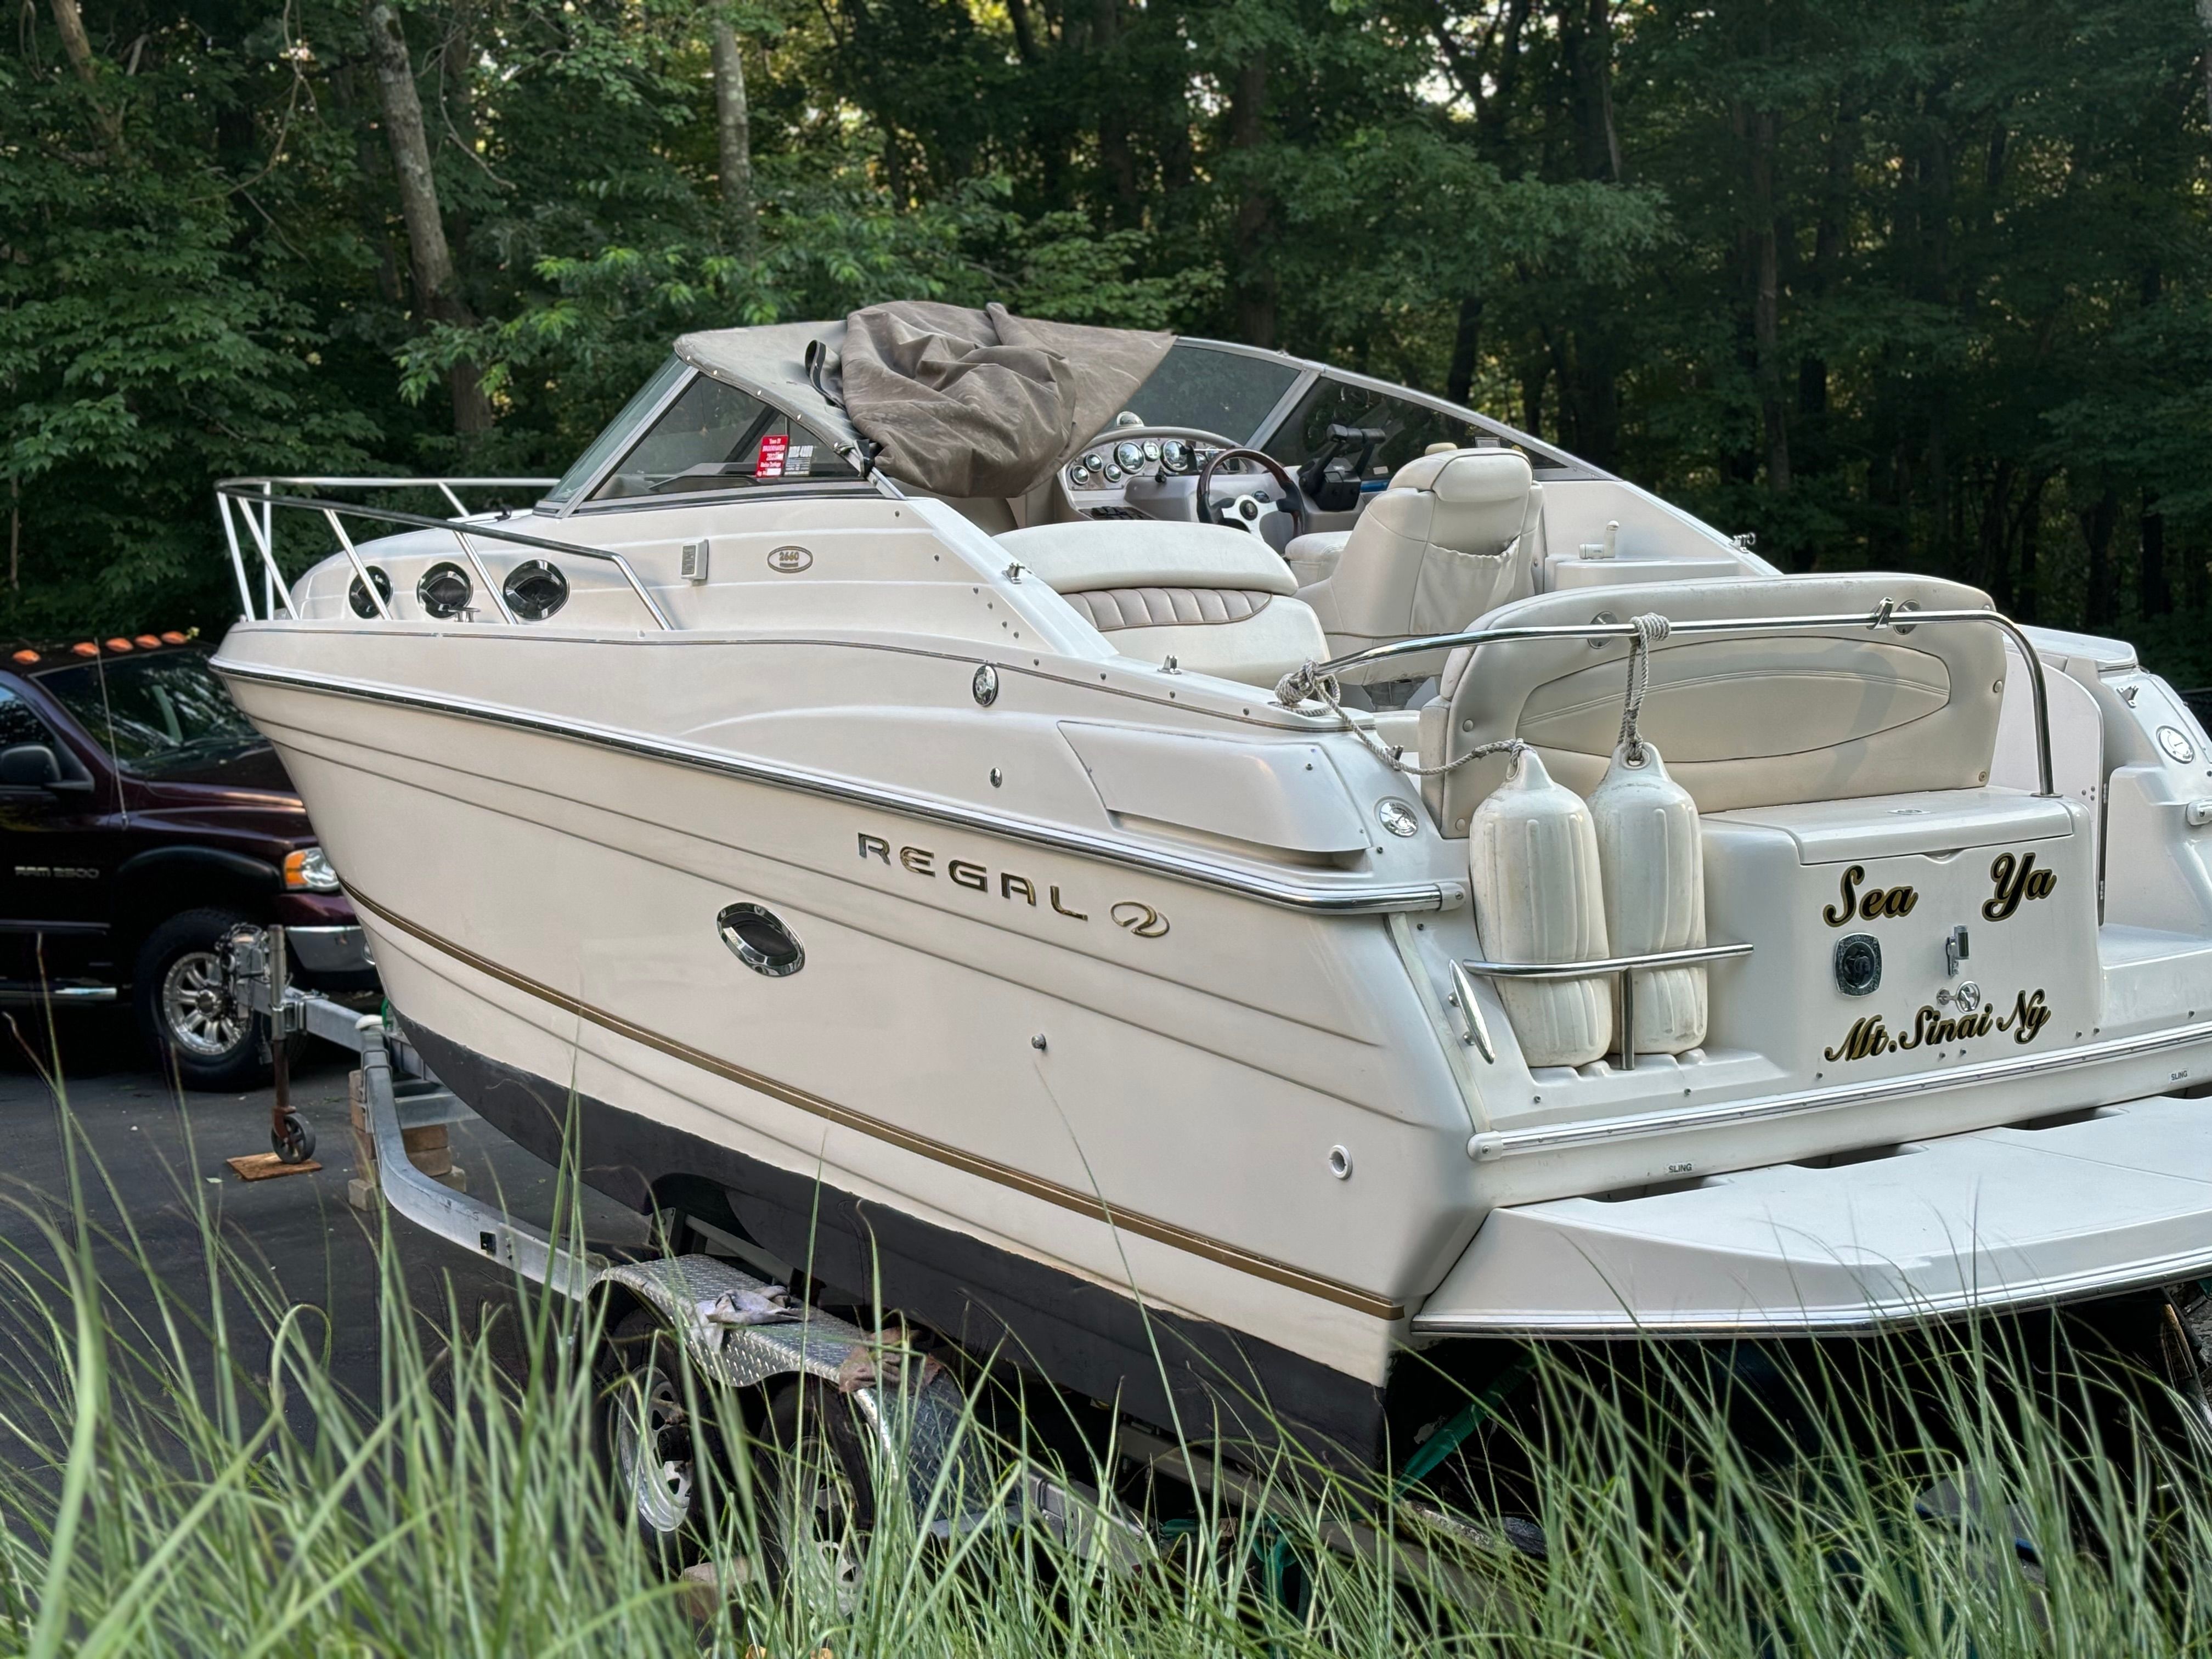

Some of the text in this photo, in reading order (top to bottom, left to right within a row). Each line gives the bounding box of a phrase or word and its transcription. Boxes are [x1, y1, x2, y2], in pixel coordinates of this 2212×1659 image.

[779, 551, 799, 561] 2660
[857, 832, 1088, 921] REGAL
[1822, 852, 2057, 928] Sea Ya
[1996, 989, 2052, 1045] Ny
[2171, 1070, 2188, 1081] SLING
[1668, 1163, 1692, 1173] SLING
